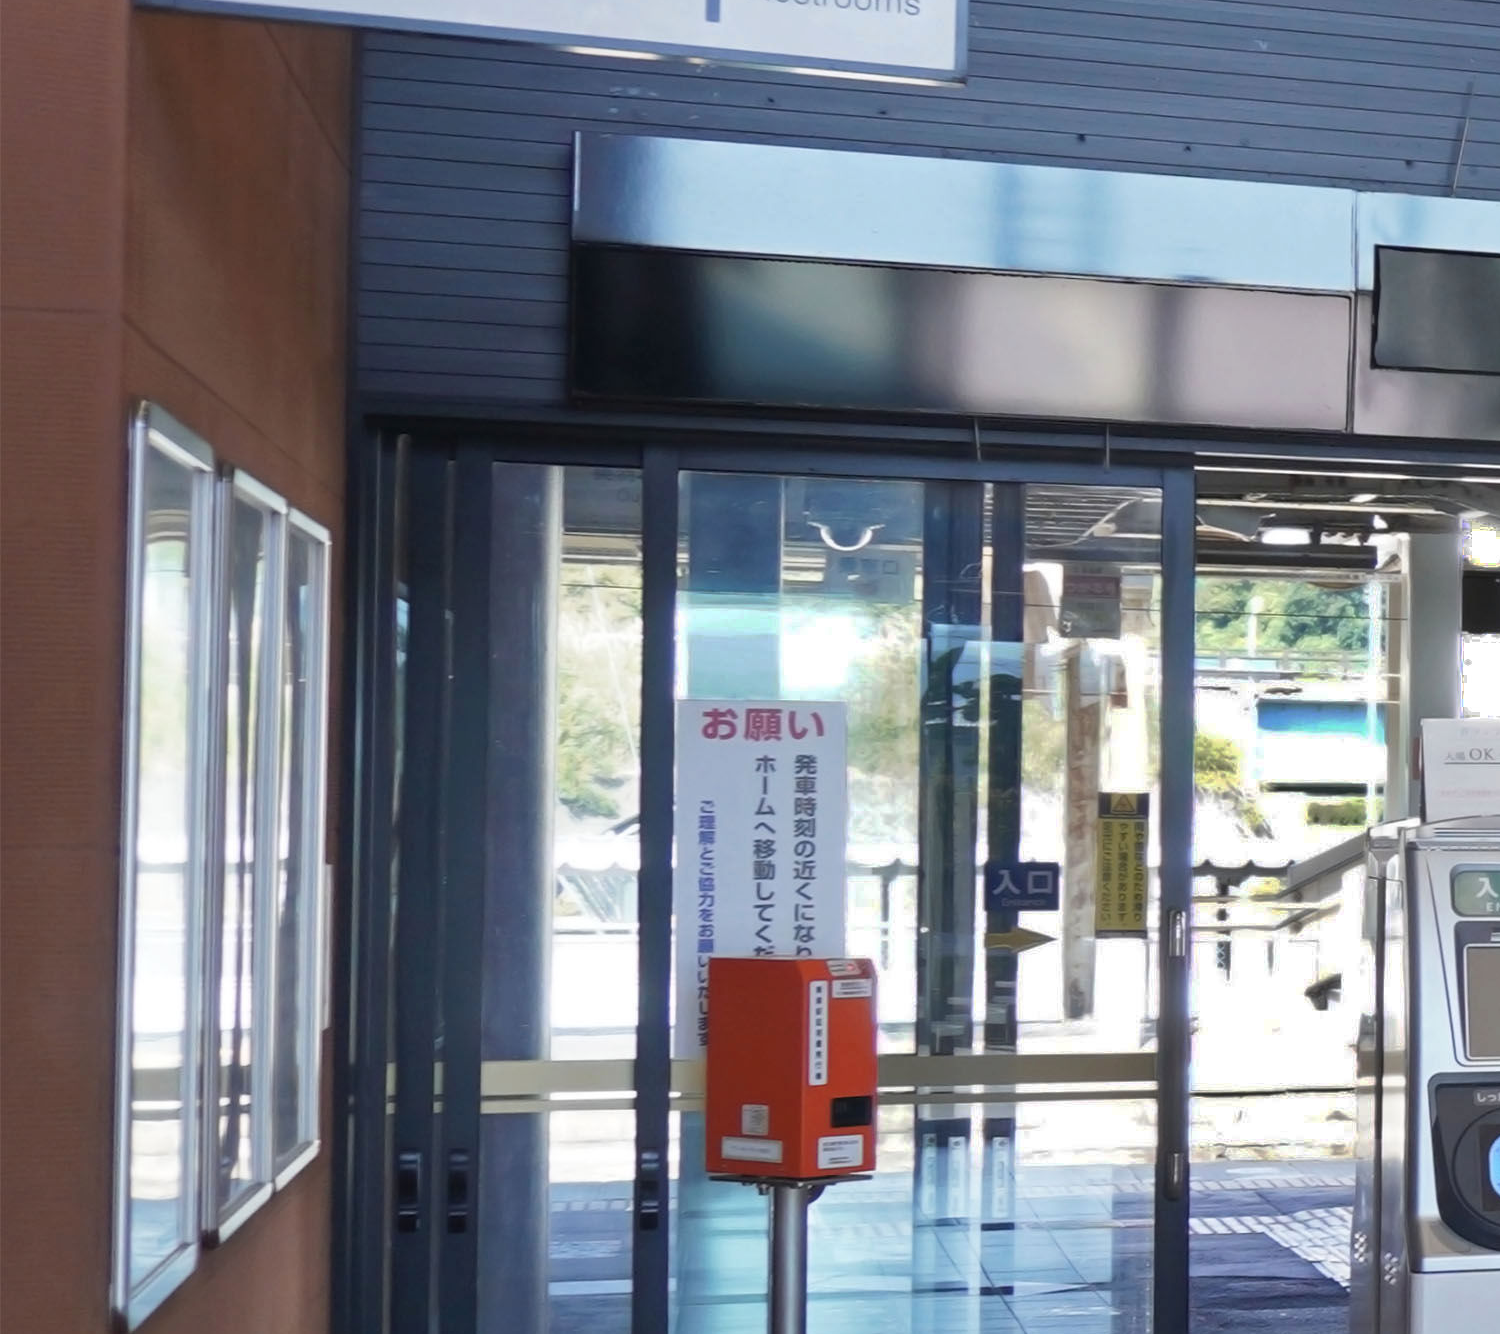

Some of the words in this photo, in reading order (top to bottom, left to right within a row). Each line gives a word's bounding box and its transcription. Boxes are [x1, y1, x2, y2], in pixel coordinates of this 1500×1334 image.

[702, 708, 824, 741] お願い
[1469, 748, 1495, 761] OK
[753, 755, 776, 957] ホームへ移動してくだ
[794, 755, 816, 958] 発車時刻の近くになり
[992, 869, 1053, 895] 入口
